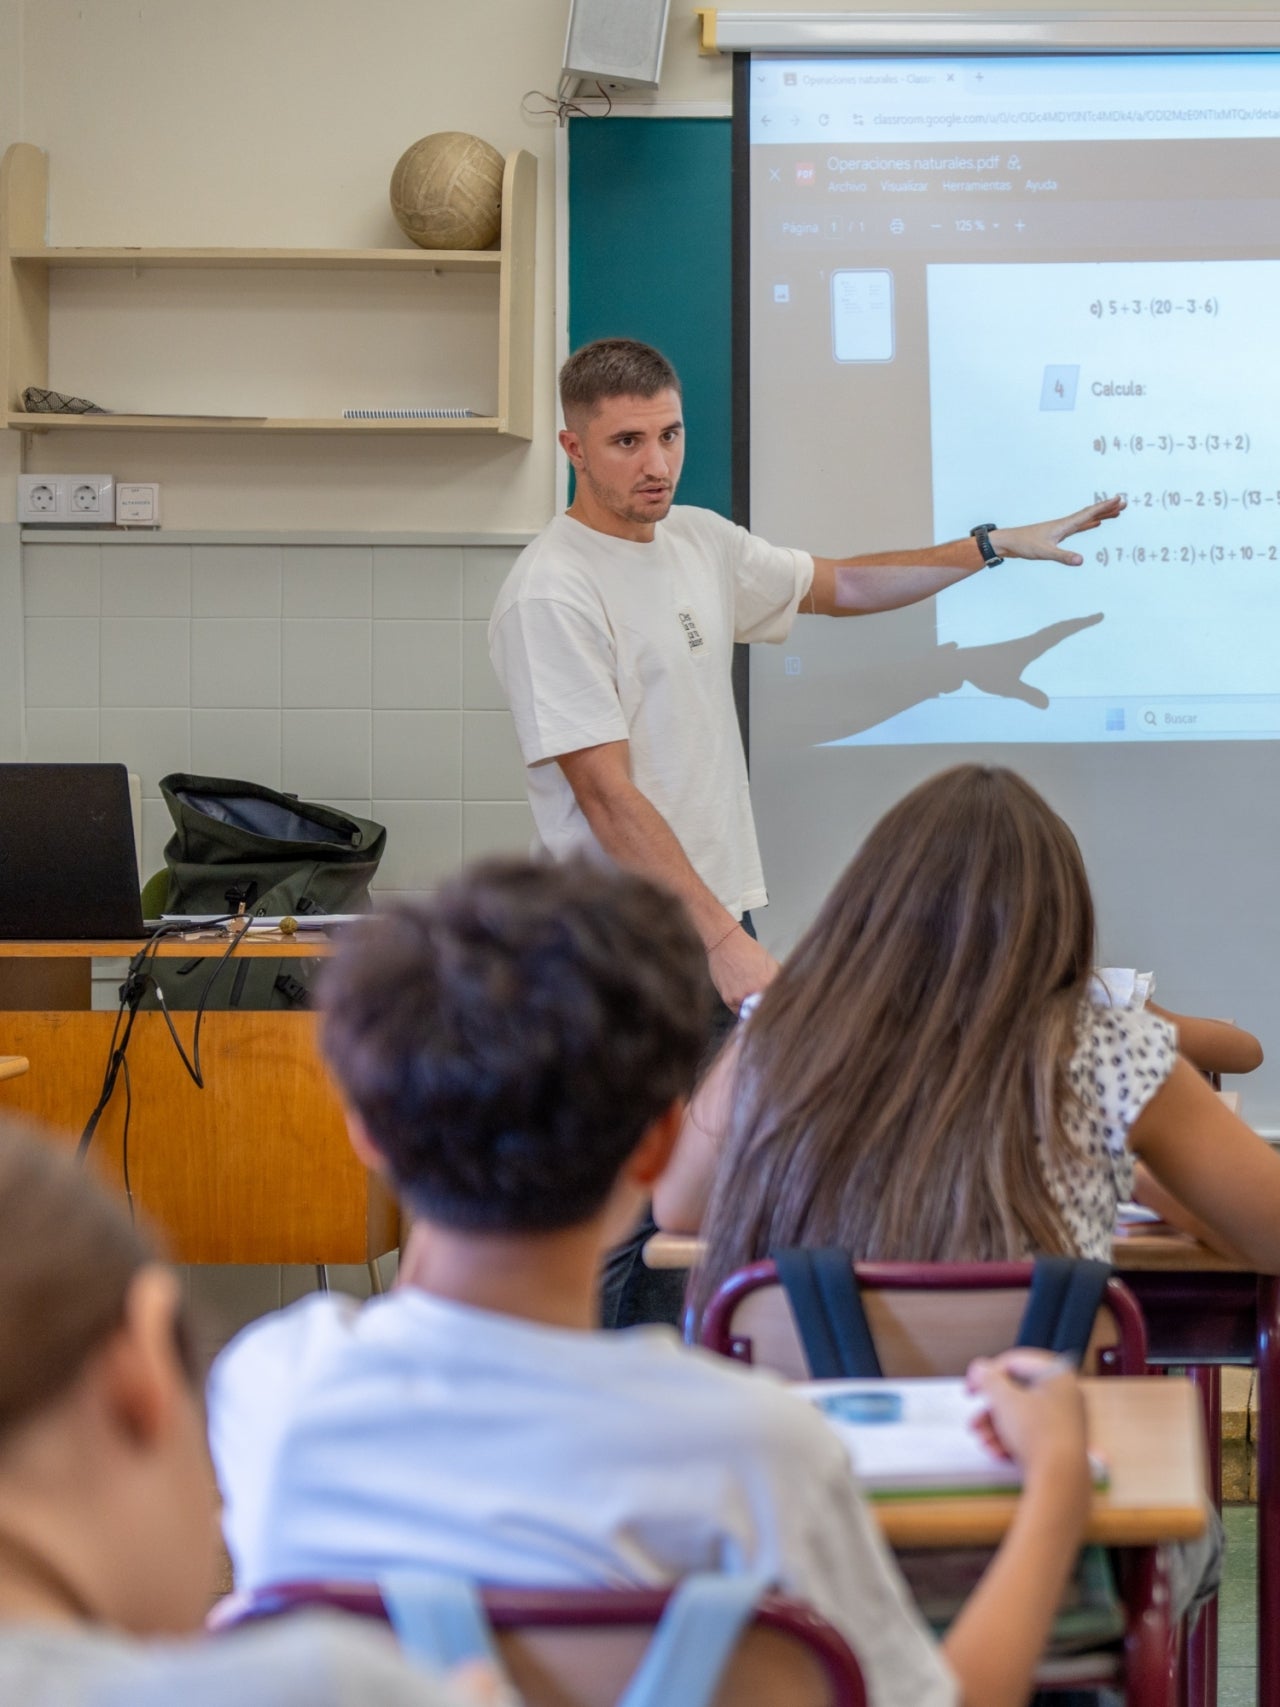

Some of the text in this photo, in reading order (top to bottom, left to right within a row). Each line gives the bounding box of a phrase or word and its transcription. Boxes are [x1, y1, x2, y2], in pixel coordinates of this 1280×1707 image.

[827, 155, 1001, 173] Operaciones naturales.pdf
[827, 179, 1058, 193] Archivo Visualizar Herramientas Ayuda
[1091, 380, 1147, 398] Calcula:
[1164, 712, 1198, 725] Buscar
